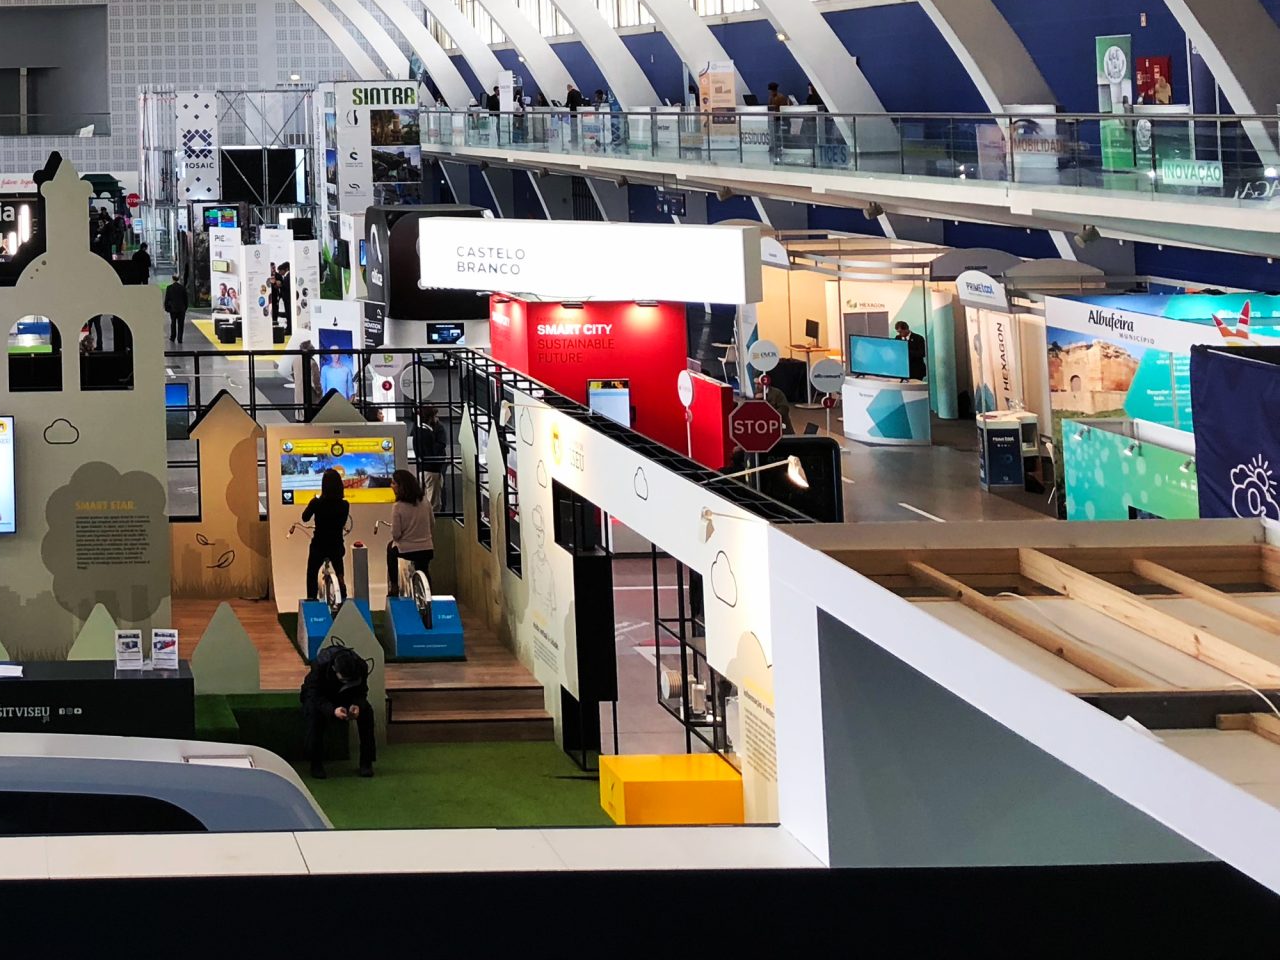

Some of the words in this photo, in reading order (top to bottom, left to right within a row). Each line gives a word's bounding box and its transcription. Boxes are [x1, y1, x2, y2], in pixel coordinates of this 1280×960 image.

[457, 246, 525, 260] CASTELO
[457, 261, 520, 275] BRANCO
[1088, 309, 1134, 332] Albufeira
[537, 324, 580, 336] SMART
[582, 324, 612, 335] CITY
[538, 338, 615, 350] SUSTAINABLE
[538, 352, 583, 364] FUTURE
[996, 322, 1011, 392] HEXAGON
[734, 420, 778, 434] STOP
